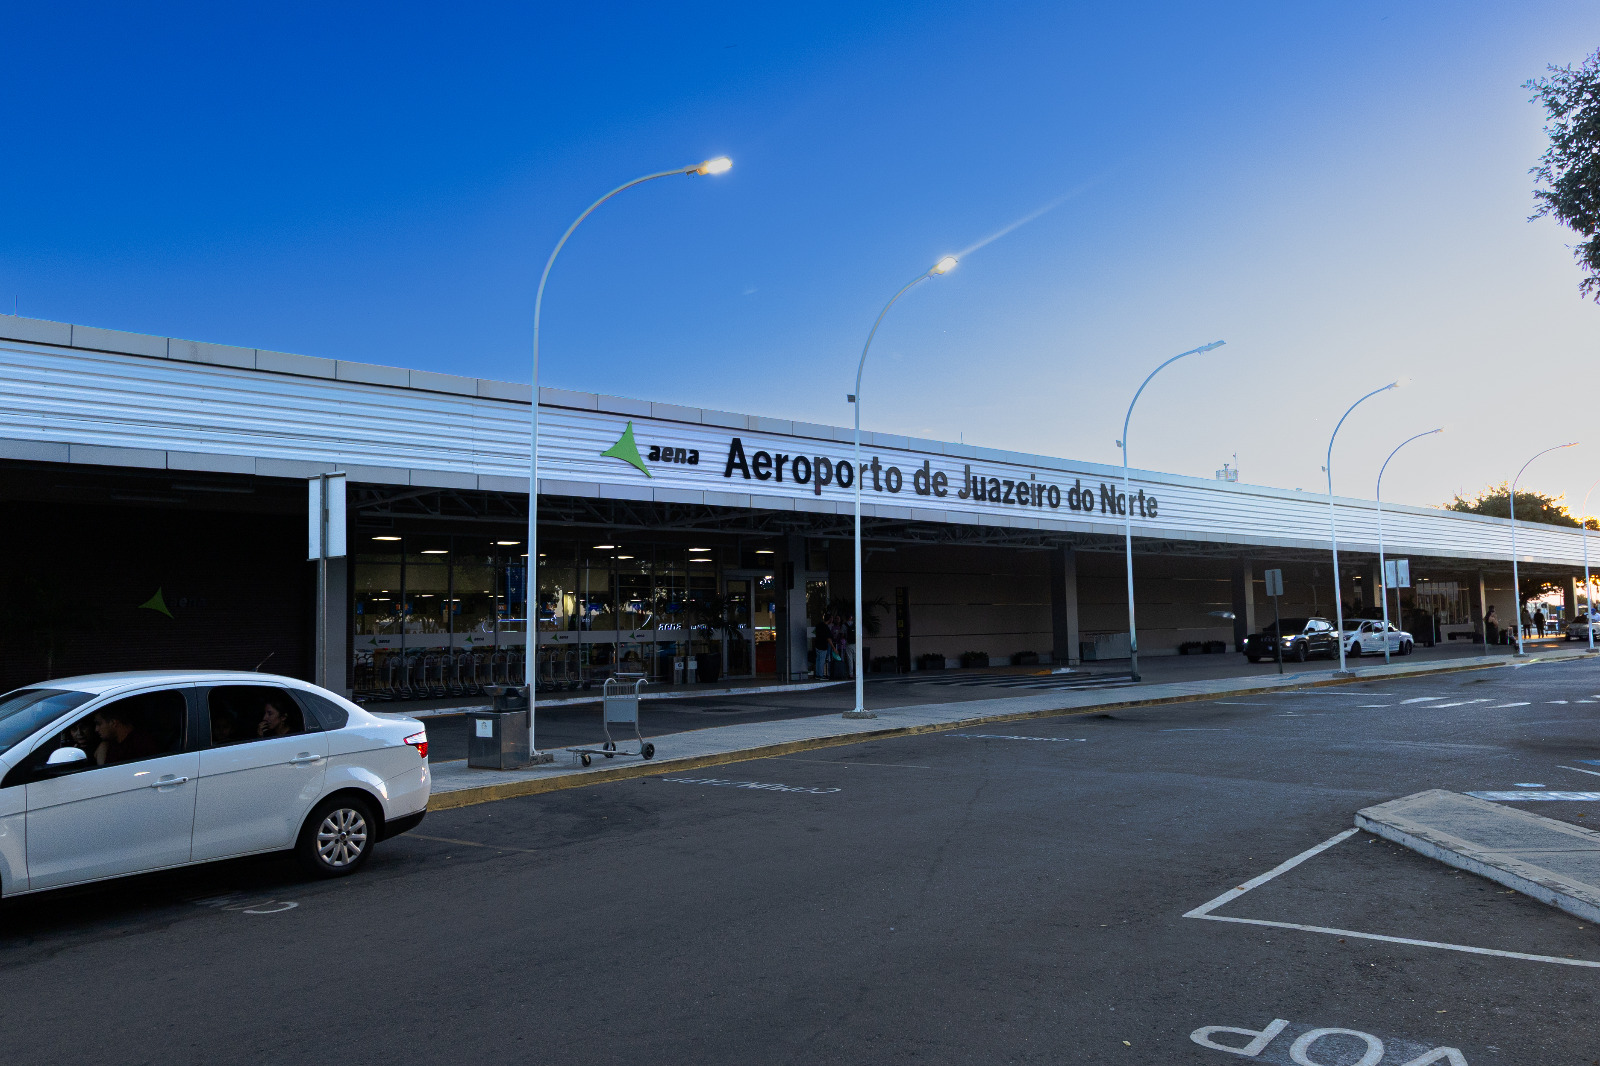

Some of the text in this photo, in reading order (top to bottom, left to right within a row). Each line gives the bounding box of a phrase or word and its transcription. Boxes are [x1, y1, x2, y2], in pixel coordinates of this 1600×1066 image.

[648, 444, 699, 465] aena
[724, 437, 1158, 518] Aeroporto de Juazeiro do Norte
